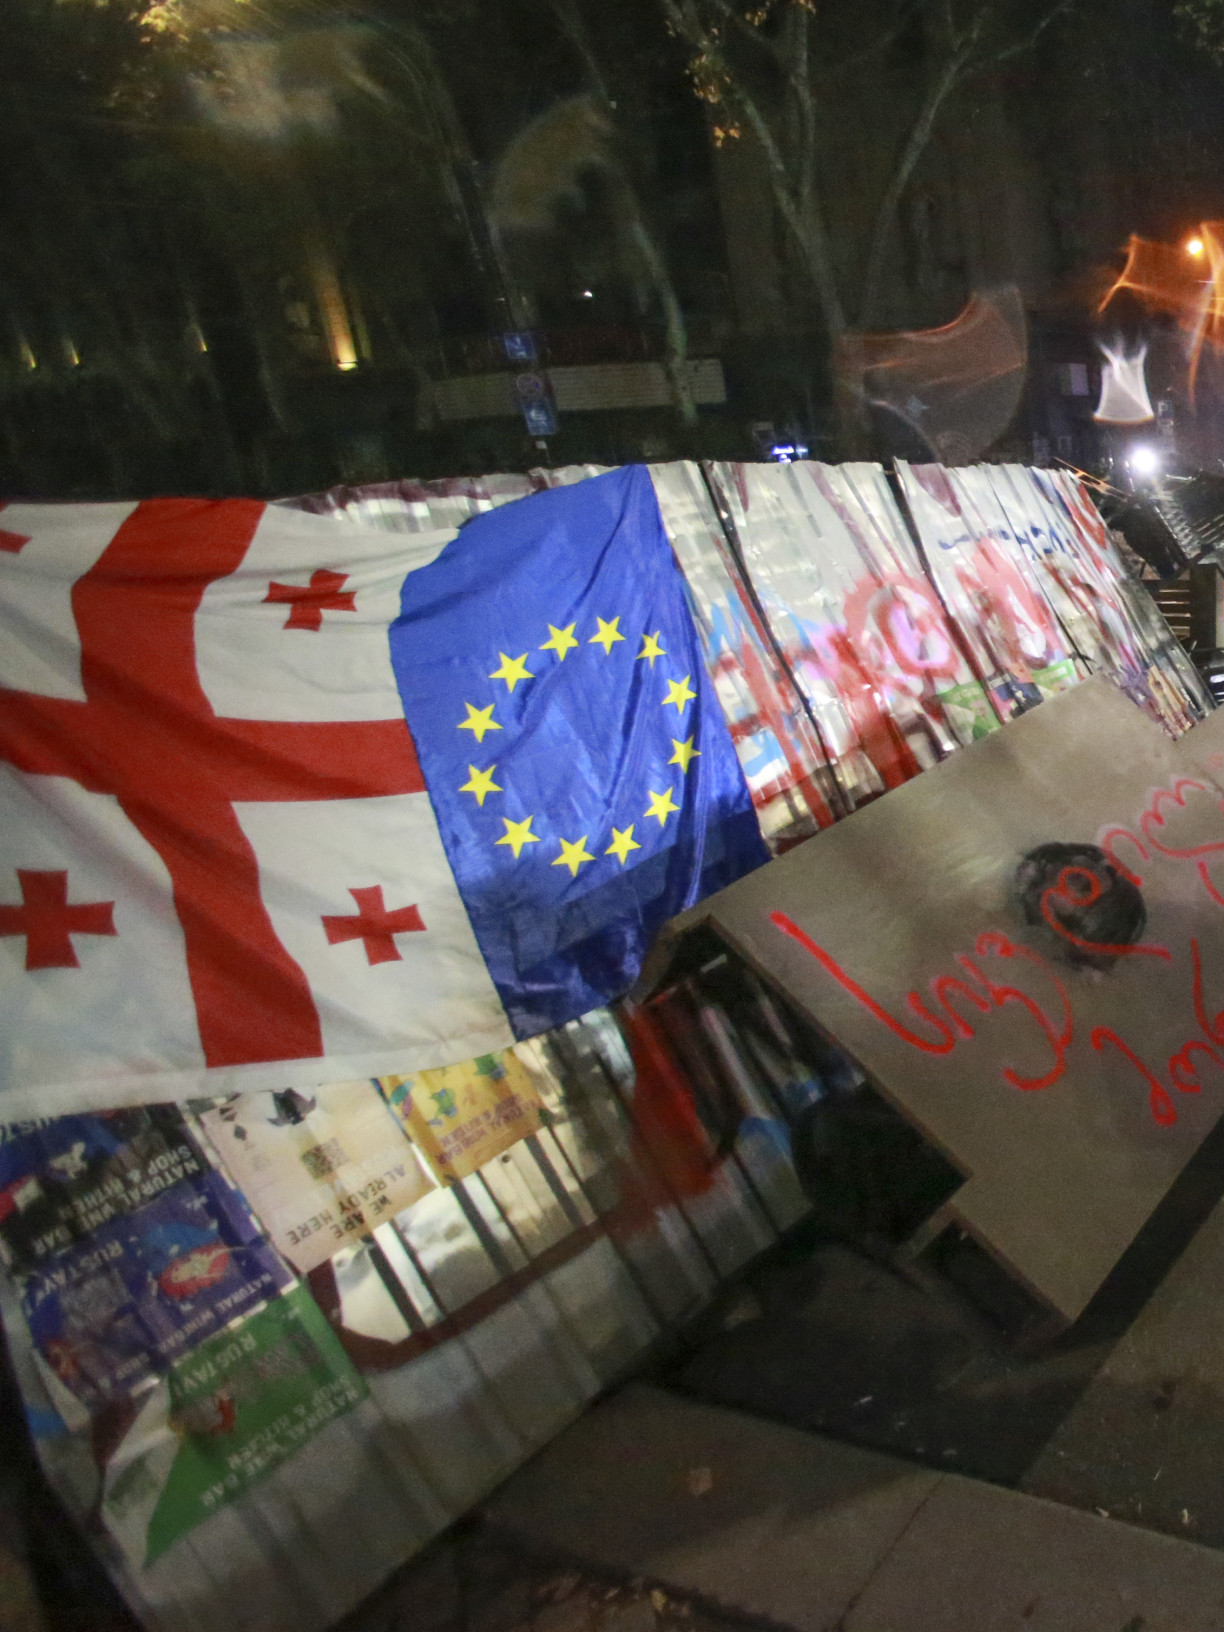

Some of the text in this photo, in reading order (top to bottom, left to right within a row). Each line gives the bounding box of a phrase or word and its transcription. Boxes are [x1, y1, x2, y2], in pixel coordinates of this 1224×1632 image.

[118, 1157, 200, 1208] NATURAL
[127, 1167, 141, 1184] &
[149, 1145, 192, 1176] SHOP
[286, 1164, 406, 1246] ALREADY HERE
[333, 1195, 392, 1239] WE ARE
[33, 1224, 73, 1254] BAR
[214, 1272, 272, 1314] NATURAL
[172, 1333, 257, 1397] RUSTAVI
[286, 1383, 359, 1442] NATURAL
